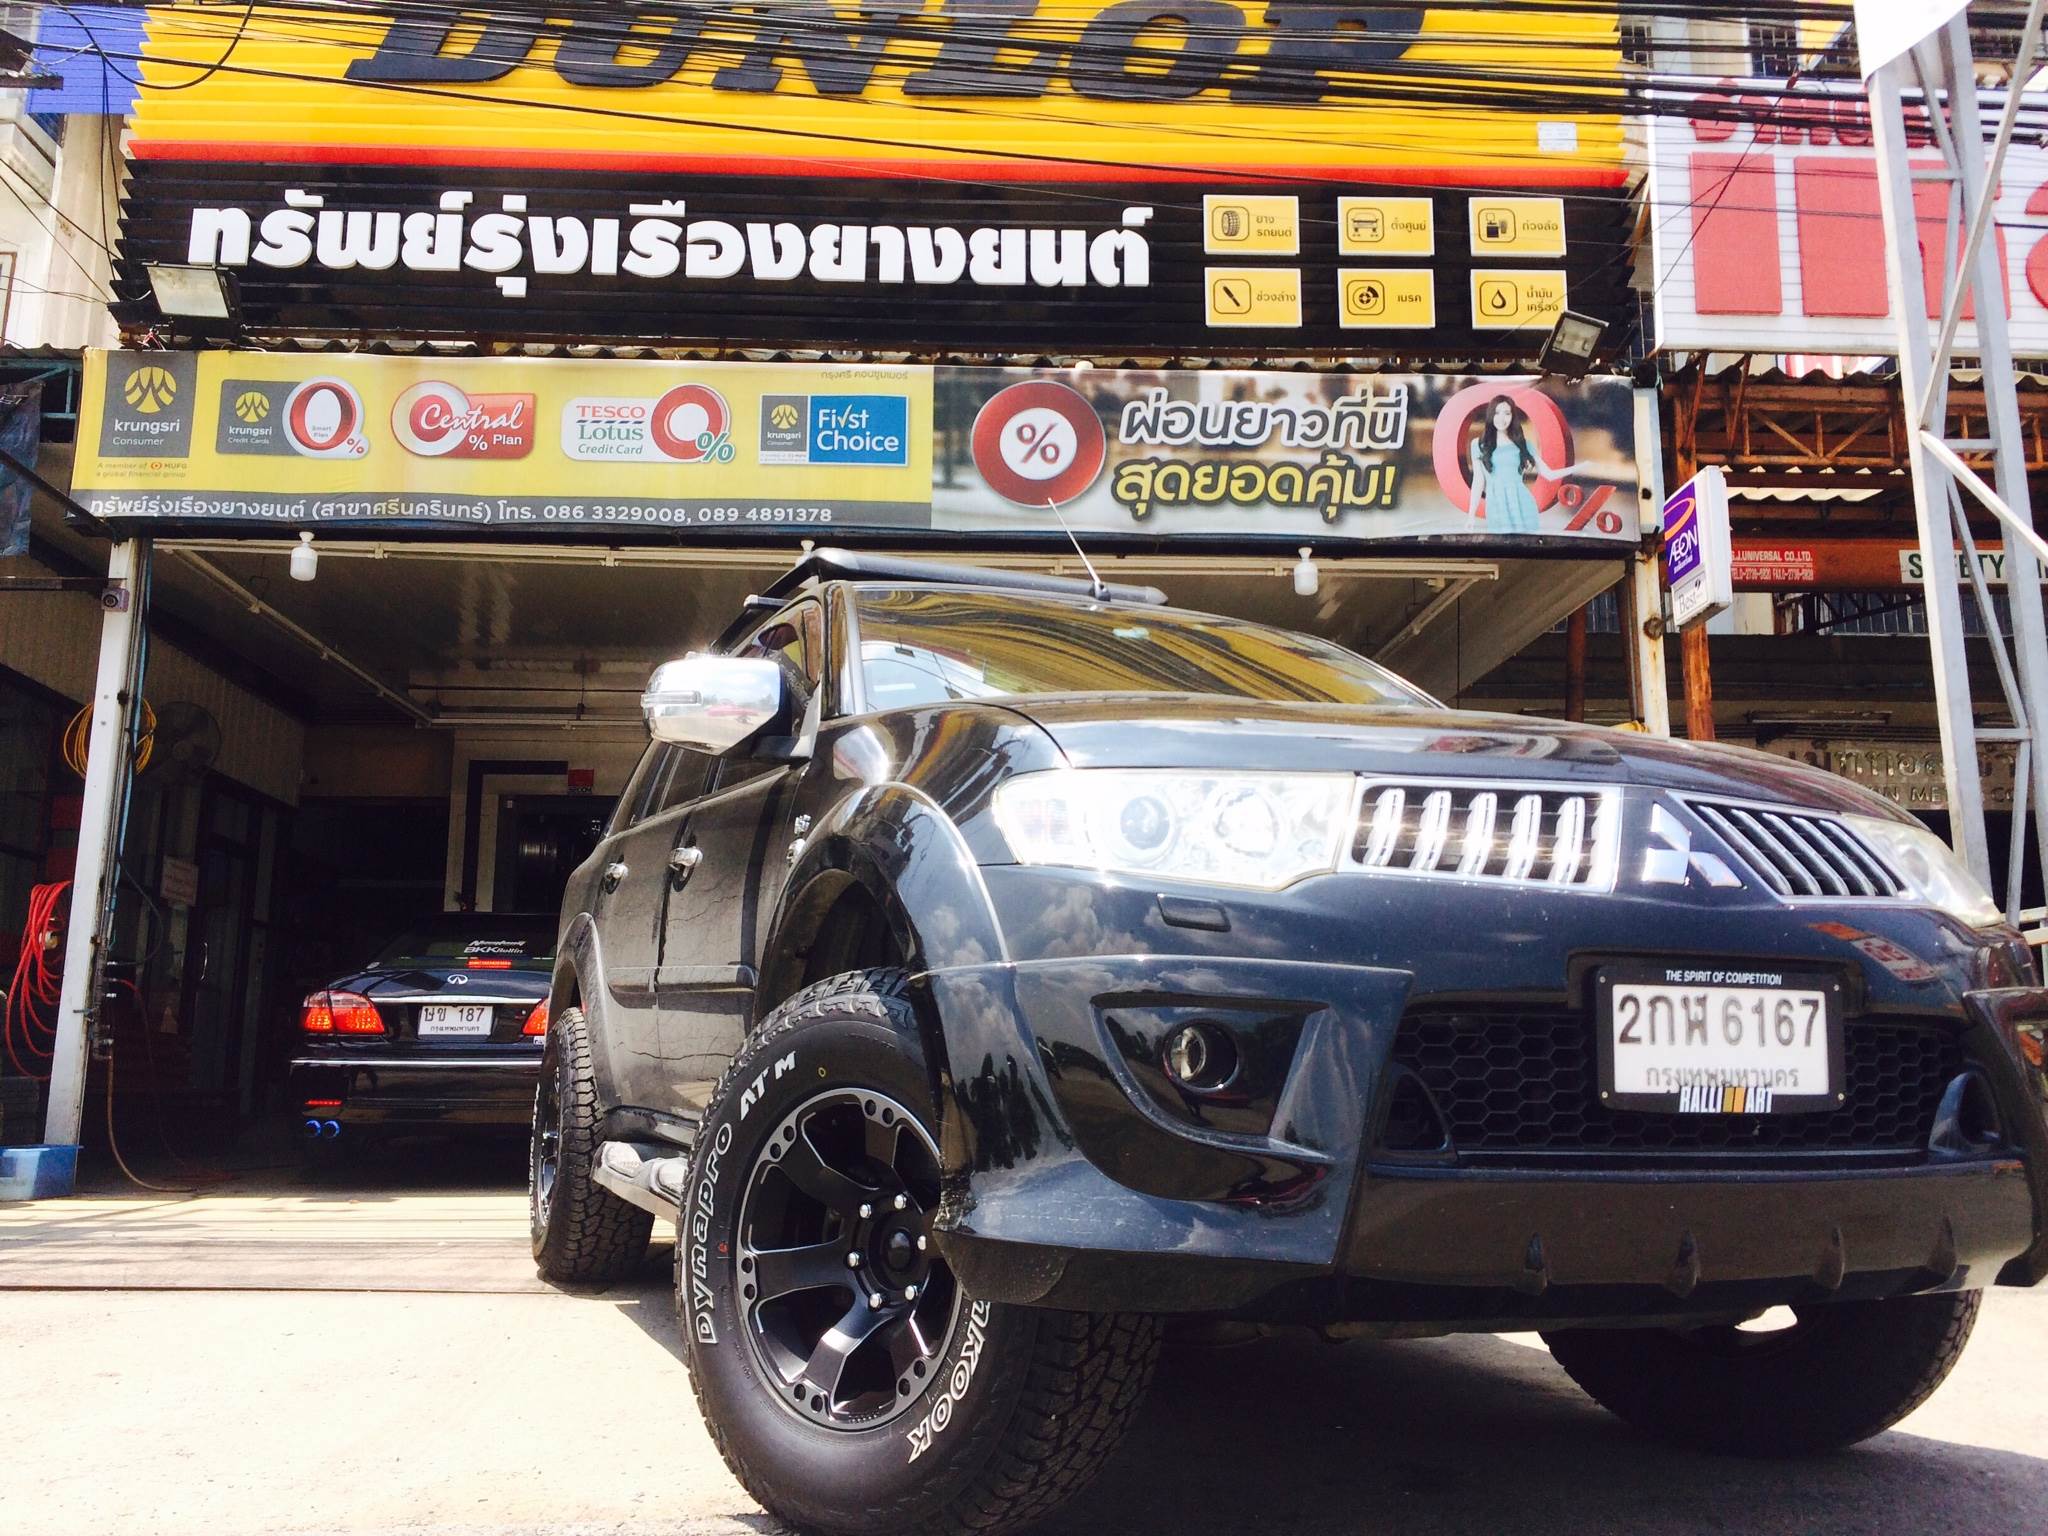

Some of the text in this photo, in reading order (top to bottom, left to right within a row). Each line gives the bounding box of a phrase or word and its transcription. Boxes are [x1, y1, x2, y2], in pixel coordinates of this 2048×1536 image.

[345, 0, 1425, 101] DUNLOP
[187, 188, 1154, 298] ทรัพย์รุ่งเรืองยางยนต์
[420, 399, 524, 430] Central
[576, 405, 646, 418] TESCO
[1125, 387, 1404, 444] ผ่อนยาวที่นี่
[114, 418, 180, 434] krungsri
[229, 426, 272, 437] krungsri
[579, 424, 644, 441] Lotus
[112, 436, 164, 446] Consumer
[492, 434, 522, 446] Plan
[578, 443, 643, 454] Credit Card
[816, 430, 899, 451] Choice
[1114, 453, 1397, 518] สุดยอดคุ้ม!
[498, 501, 536, 520] โทร.
[543, 504, 584, 521] 086
[591, 506, 691, 525] 3329008,
[698, 509, 739, 522] 089
[745, 509, 832, 523] 4891378
[1908, 553, 2004, 579] SETY
[1666, 970, 1782, 985] THE SPIRIT OF COMPETITION
[459, 1007, 485, 1022] 187
[1721, 999, 1820, 1047] 6167
[692, 1122, 733, 1344] Dynapro
